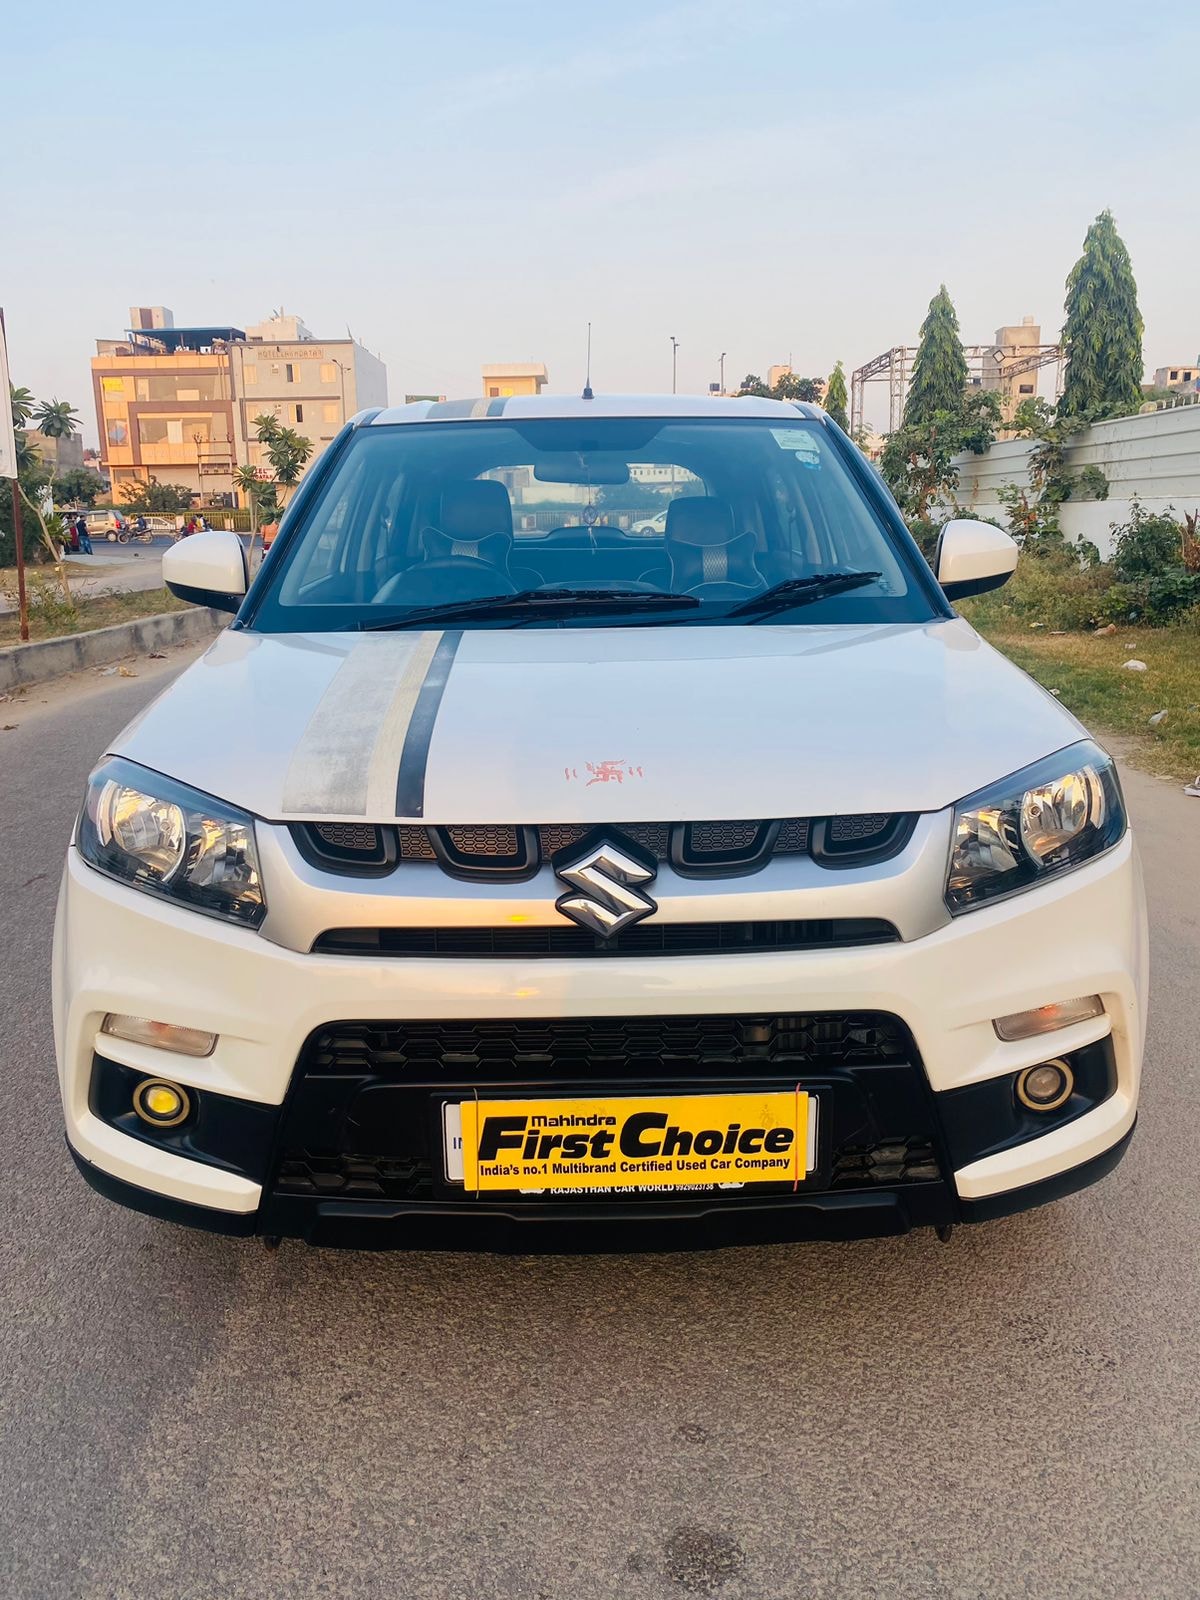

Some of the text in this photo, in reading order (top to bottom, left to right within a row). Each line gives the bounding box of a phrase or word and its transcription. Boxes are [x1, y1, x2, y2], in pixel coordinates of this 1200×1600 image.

[531, 1114, 616, 1127] Mahindra
[478, 1111, 795, 1161] First Choice
[480, 1158, 790, 1176] India's no.1 Multibrand Certified Used Car Company
[551, 1186, 612, 1194] RAJASTHAN
[614, 1185, 636, 1193] CAR
[638, 1183, 674, 1192] WORLD
